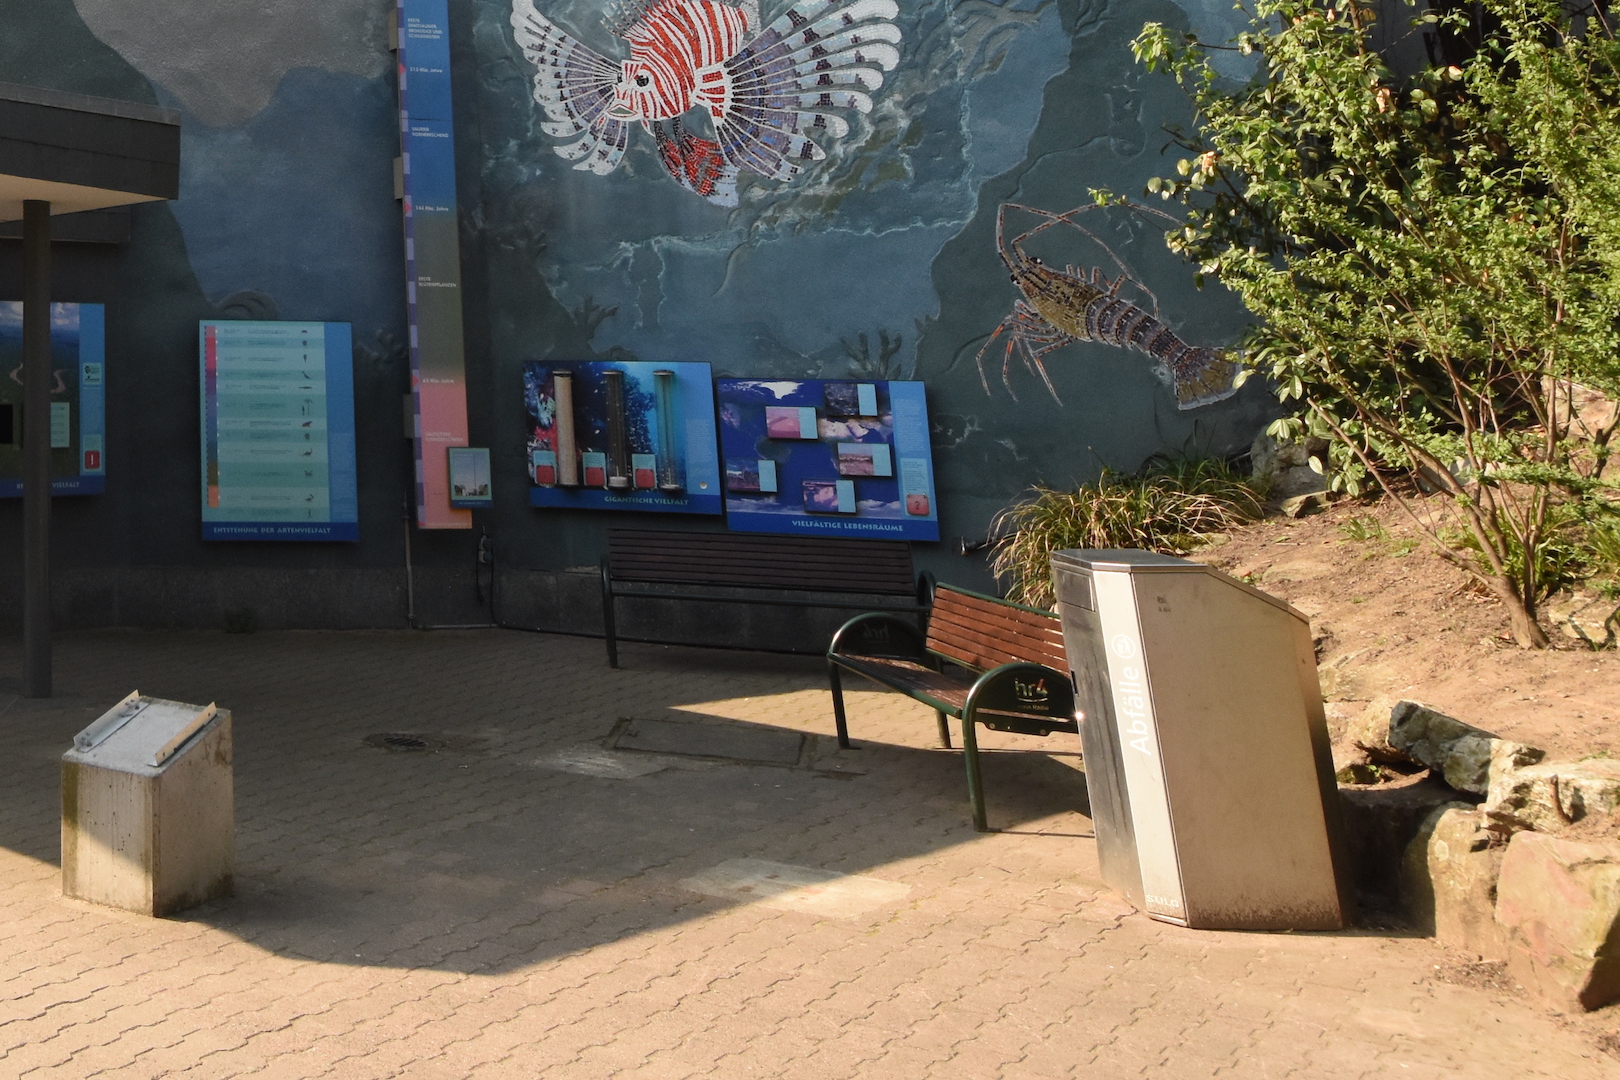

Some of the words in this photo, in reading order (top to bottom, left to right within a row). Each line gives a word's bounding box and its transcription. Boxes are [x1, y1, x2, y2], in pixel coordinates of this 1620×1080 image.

[52, 481, 80, 491] VIELFALT
[604, 496, 653, 504] GIGANTISCHE
[792, 520, 841, 529] VIELFÄLTIGE
[843, 522, 904, 531] LEBENSRÄUME
[1014, 678, 1048, 697] hr4
[1118, 666, 1151, 756] Abfälle
[1145, 894, 1180, 908] SULO
